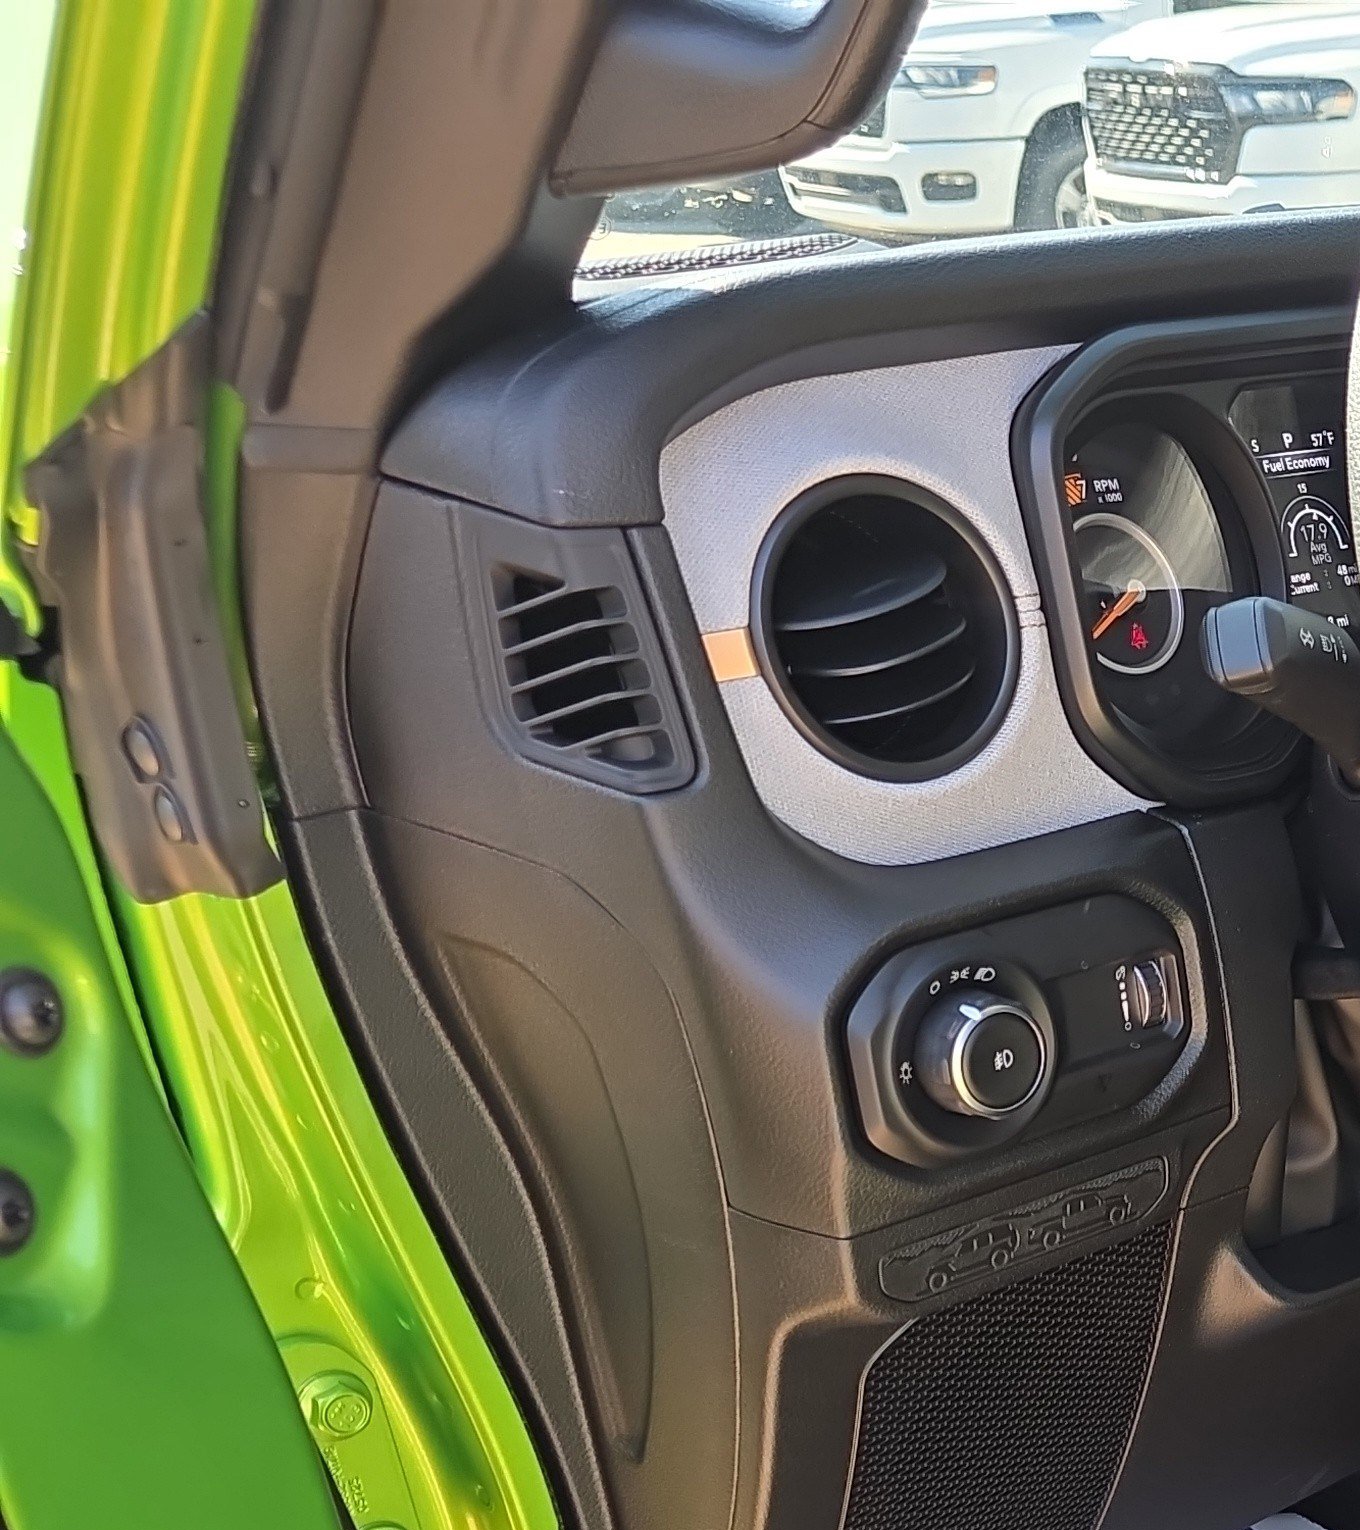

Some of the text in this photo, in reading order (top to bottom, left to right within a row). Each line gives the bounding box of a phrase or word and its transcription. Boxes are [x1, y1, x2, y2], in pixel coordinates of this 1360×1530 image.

[1281, 432, 1293, 449] P
[1310, 430, 1335, 447] 57°F
[1262, 455, 1330, 473] Fuel Economy
[1093, 478, 1120, 493] RPM
[1297, 482, 1308, 494] 15
[1105, 492, 1123, 503] 1000
[1300, 522, 1328, 542] 17.9
[1310, 541, 1328, 554] Avg
[1311, 553, 1333, 566] MPG
[1290, 572, 1312, 583] ange
